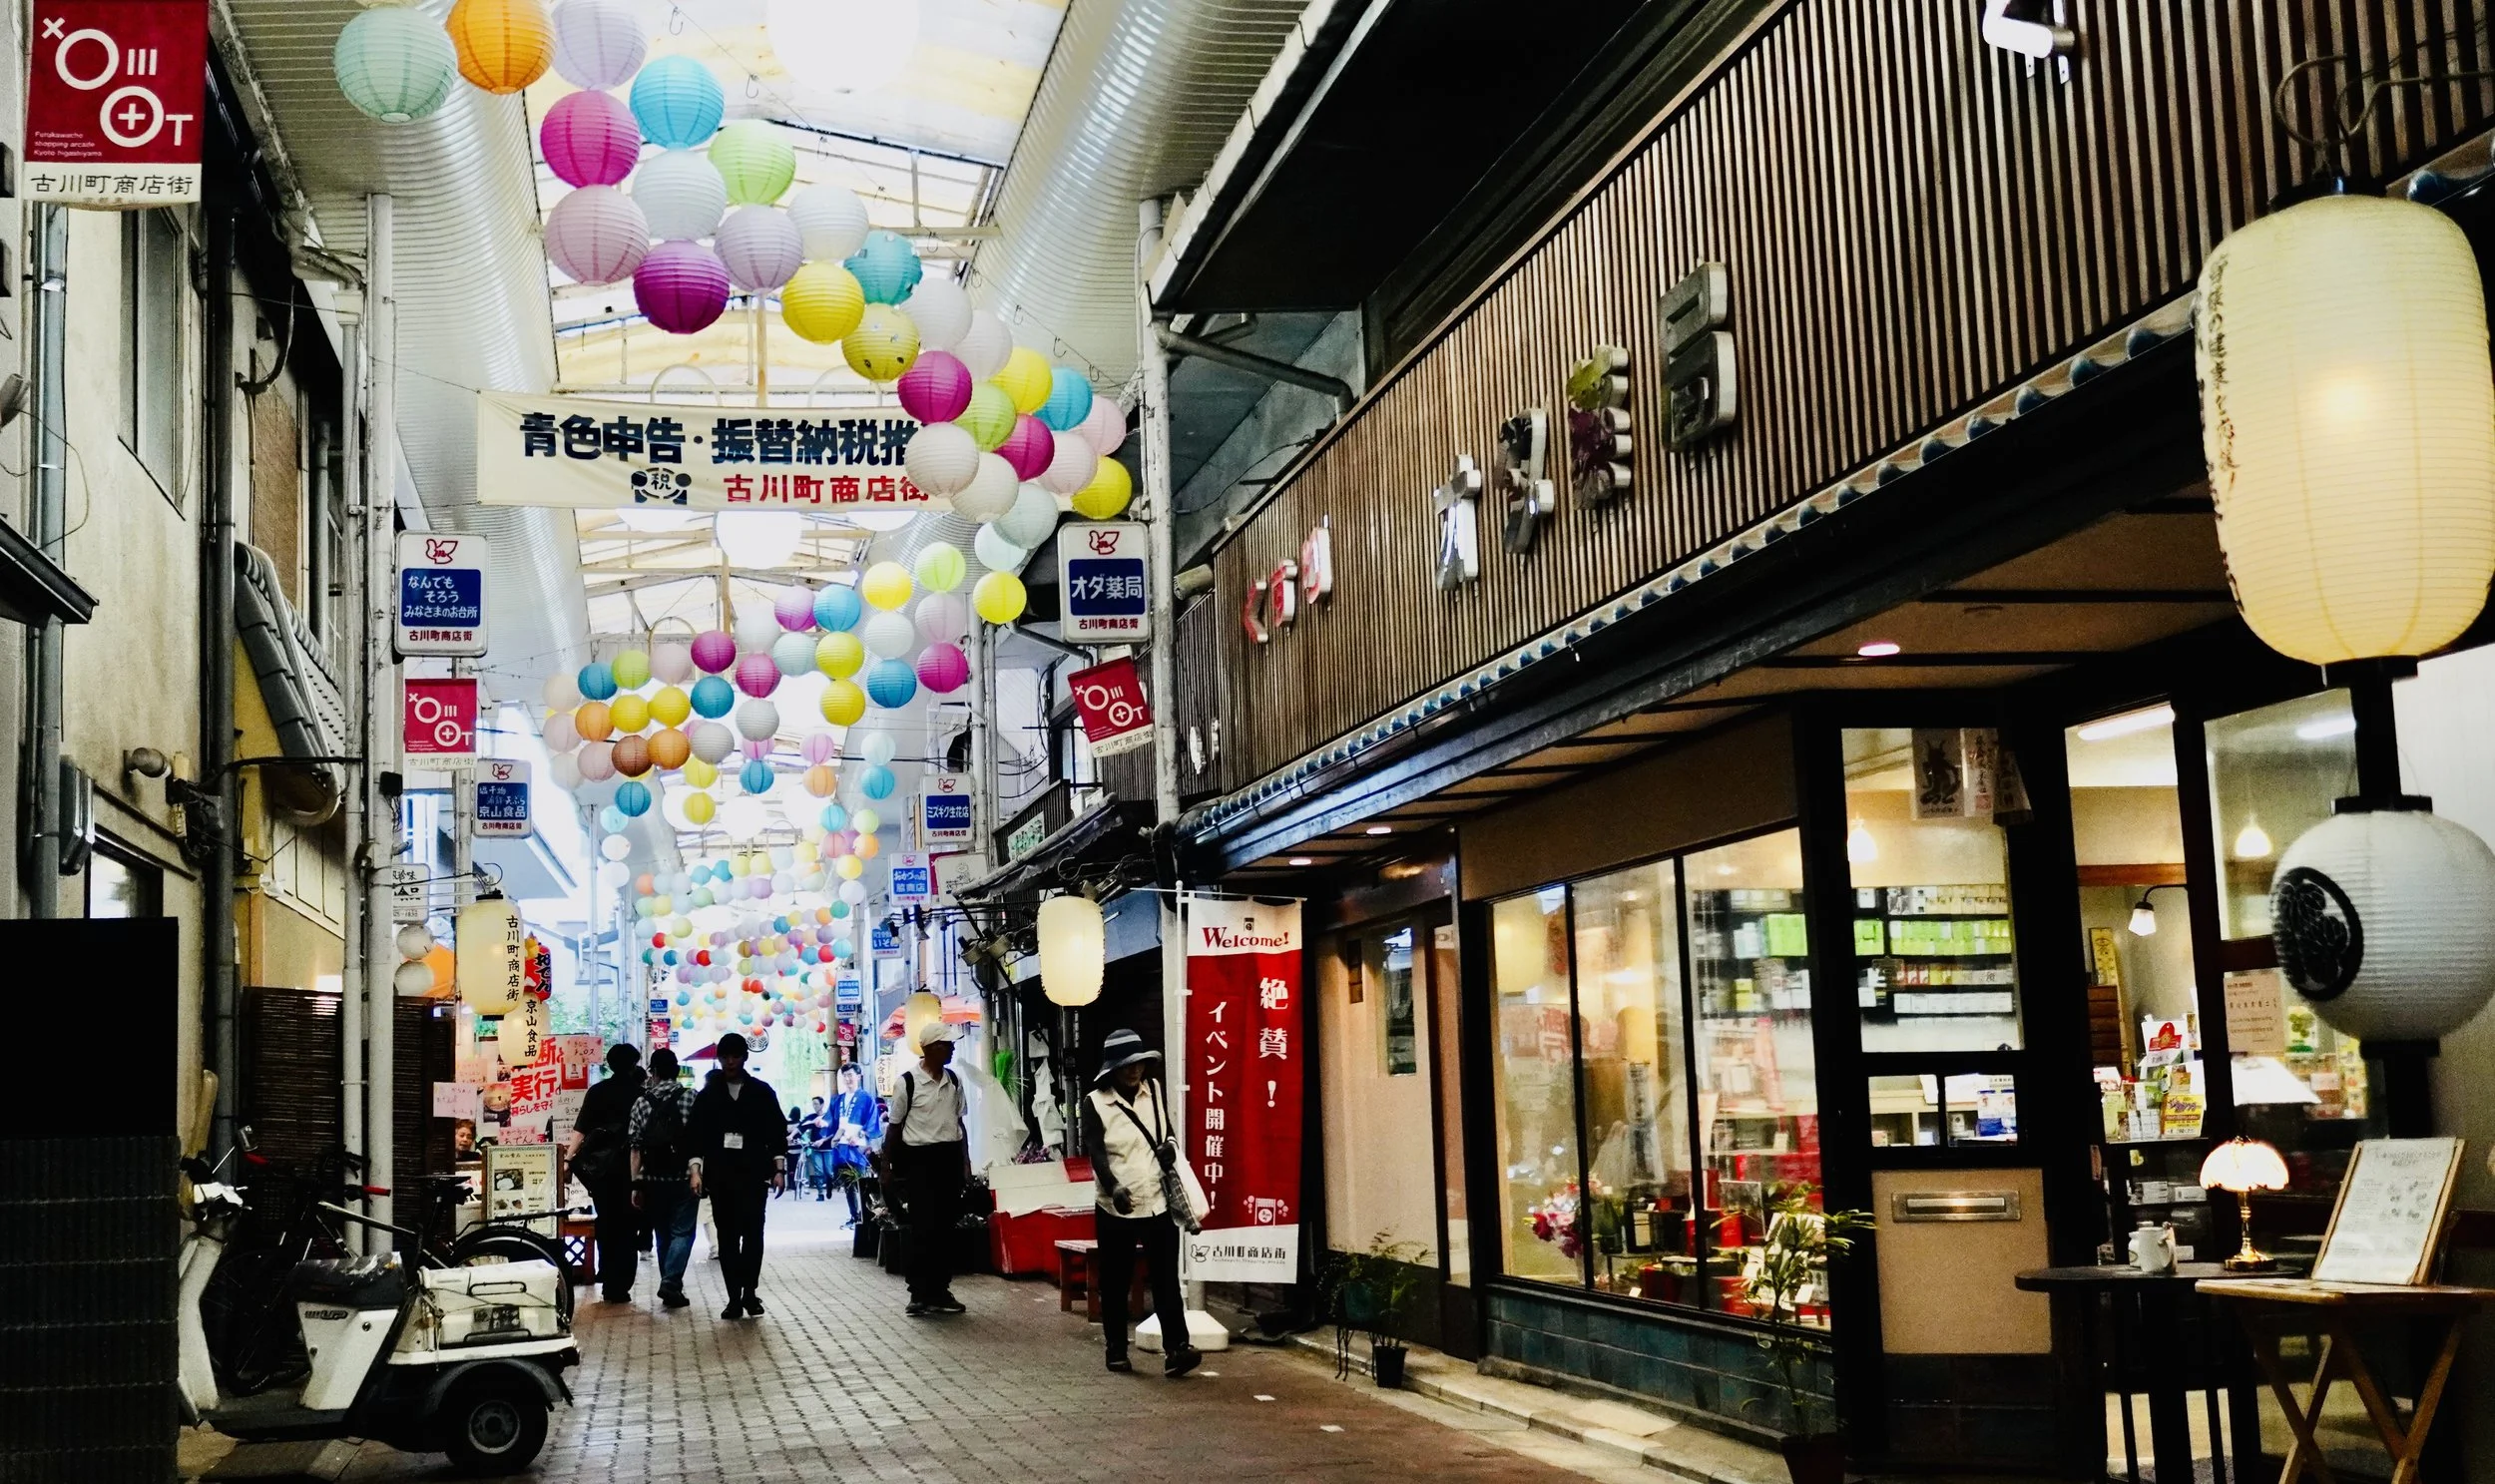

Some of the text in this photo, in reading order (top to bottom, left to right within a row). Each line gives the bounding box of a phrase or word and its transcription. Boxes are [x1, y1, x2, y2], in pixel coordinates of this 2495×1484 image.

[30, 173, 194, 195] 古川町商店街
[407, 575, 455, 589] なんでも
[1071, 573, 1143, 600] オダ薬局
[424, 590, 459, 603] そろう
[403, 605, 478, 619] みなさまのお台所
[1078, 618, 1139, 630] 古川町商店街
[408, 630, 473, 642] 古川町商店街
[479, 805, 526, 817] 京山食品
[1202, 926, 1289, 949] Welcome!
[506, 914, 520, 1002] 古川町商店街
[524, 999, 538, 1058] 京山食品
[1212, 1244, 1286, 1260] 古川町商店街
